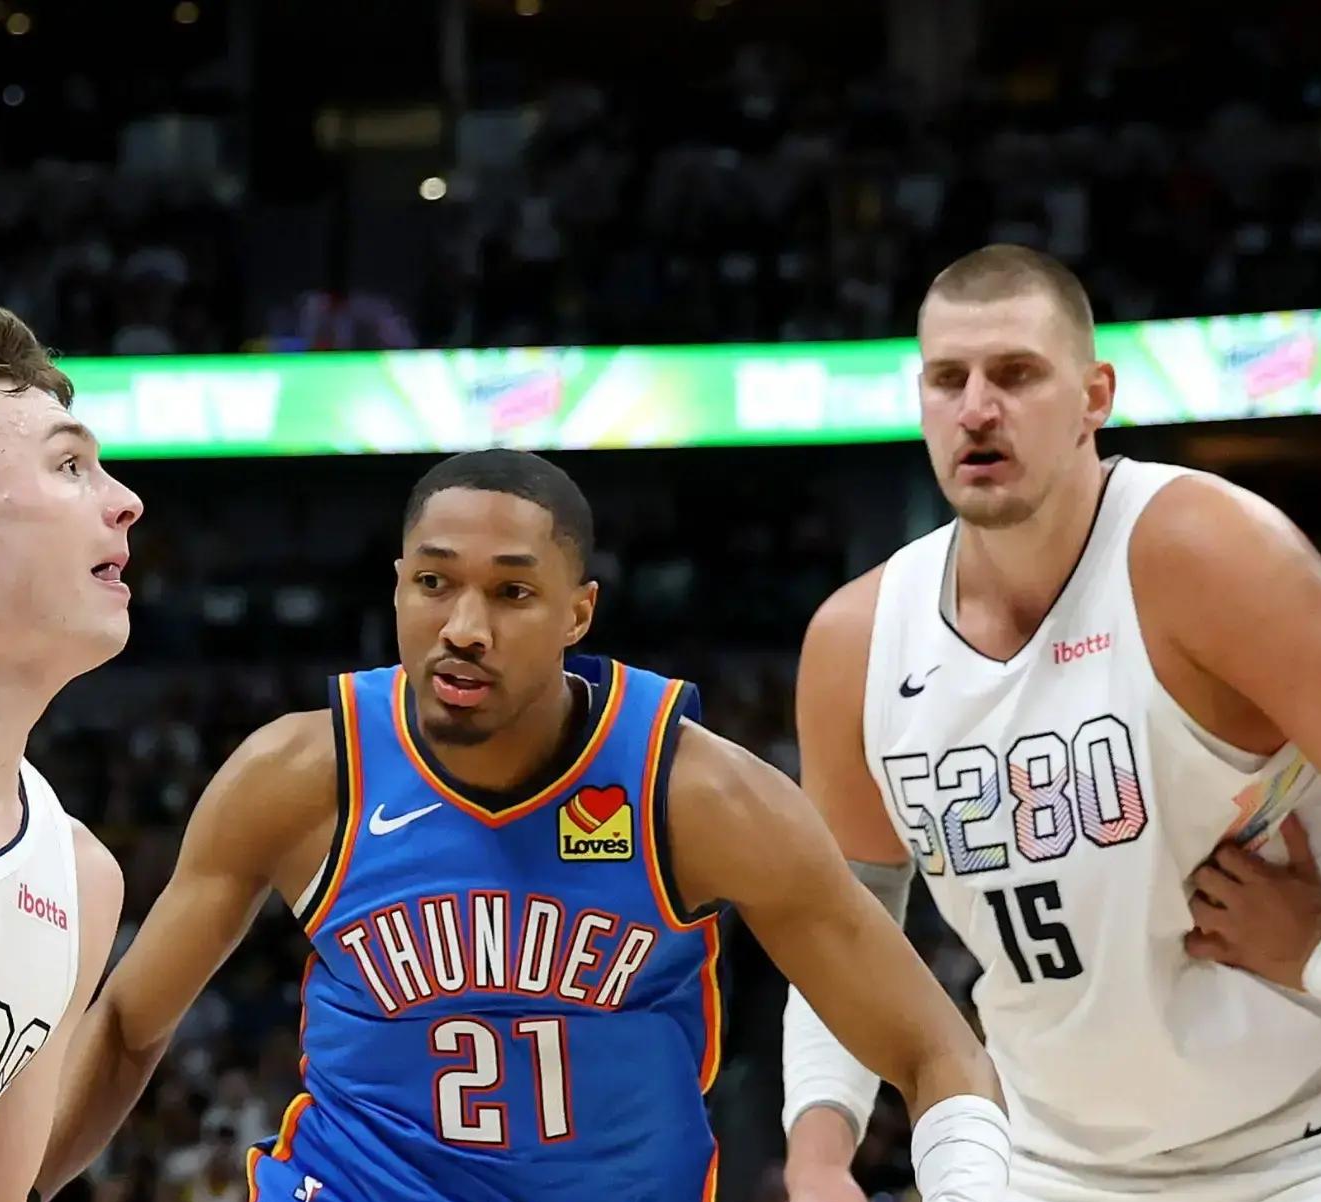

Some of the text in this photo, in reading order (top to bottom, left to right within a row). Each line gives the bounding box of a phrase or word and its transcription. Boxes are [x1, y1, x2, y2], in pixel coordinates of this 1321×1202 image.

[881, 713, 1149, 877] 5280
[18, 882, 68, 931] ibotta
[340, 889, 657, 1018] THUNDER
[983, 880, 1085, 984] 15
[430, 1016, 572, 1148] 21
